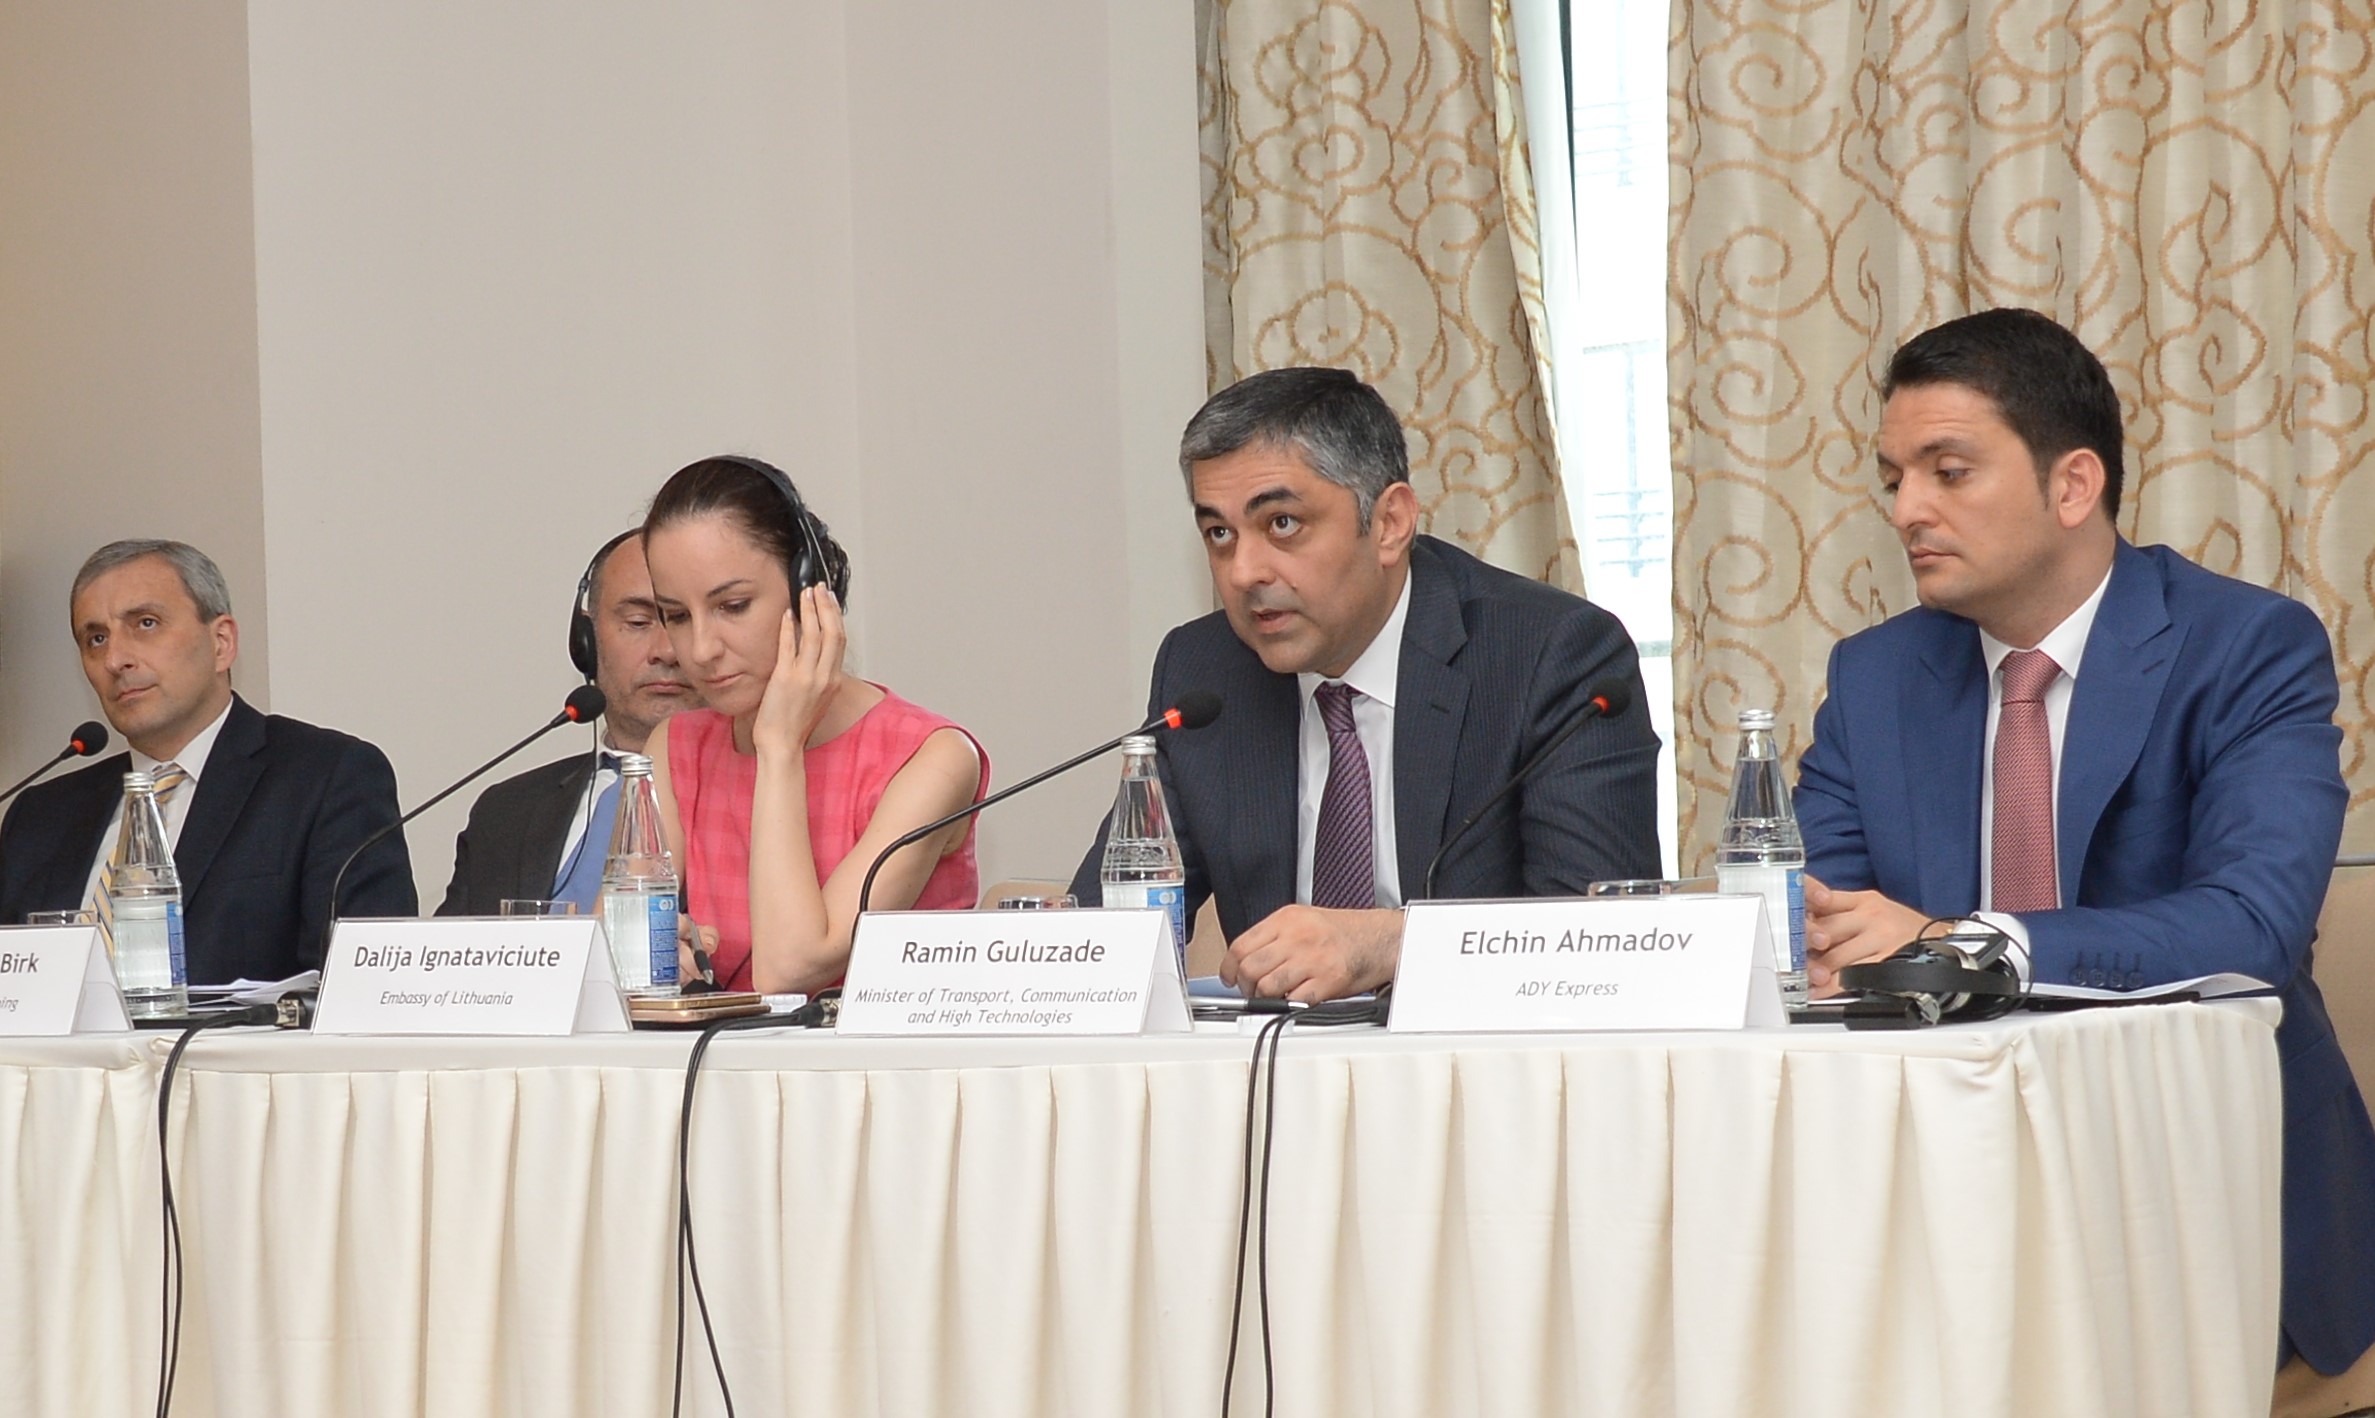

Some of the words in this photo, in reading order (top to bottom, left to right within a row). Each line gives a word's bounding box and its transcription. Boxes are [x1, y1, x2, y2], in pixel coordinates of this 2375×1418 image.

[1460, 929, 1546, 954] Elchin
[1556, 927, 1693, 953] Ahmadov
[354, 945, 412, 972] Dalija
[420, 944, 560, 972] Ignataviciute
[902, 940, 976, 963] Ramin
[987, 938, 1106, 963] Guluzade
[1, 952, 39, 973] Birk
[379, 990, 431, 1007] Embassy
[433, 990, 450, 1007] of
[451, 990, 513, 1005] Lithuania
[855, 988, 914, 1003] Minister
[918, 987, 936, 1006] of
[940, 988, 1014, 1006] Transport,
[1021, 988, 1137, 1003] Communication
[1515, 981, 1551, 997] ADY
[1554, 980, 1619, 999] Express
[0, 996, 19, 1012] ing
[907, 1009, 937, 1024] and
[938, 1009, 972, 1027] High
[978, 1009, 1073, 1027] Technologies
